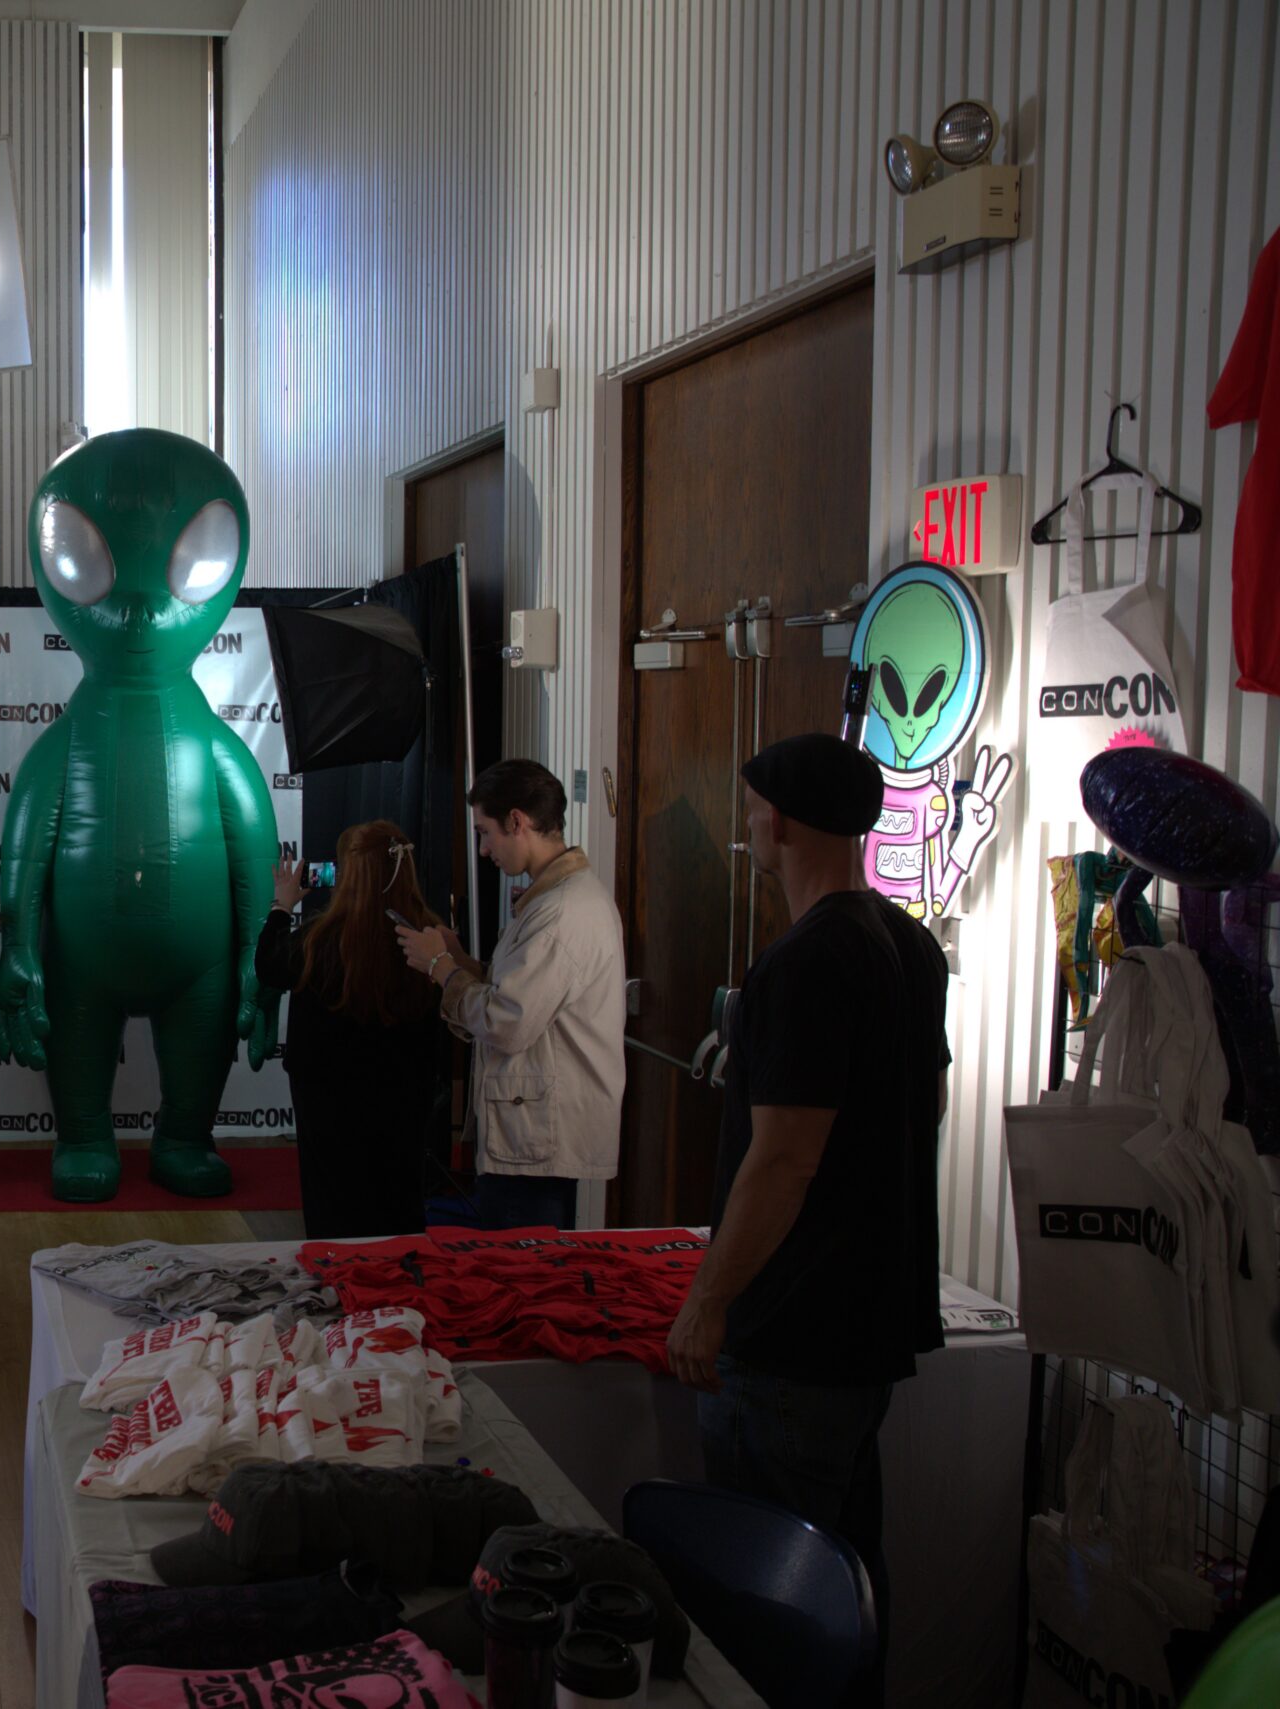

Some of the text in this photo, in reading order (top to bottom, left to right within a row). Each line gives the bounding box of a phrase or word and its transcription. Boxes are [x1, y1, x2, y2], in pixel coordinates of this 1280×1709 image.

[923, 482, 988, 566] EXIT
[150, 1379, 183, 1433] THE
[353, 1379, 383, 1419] THE
